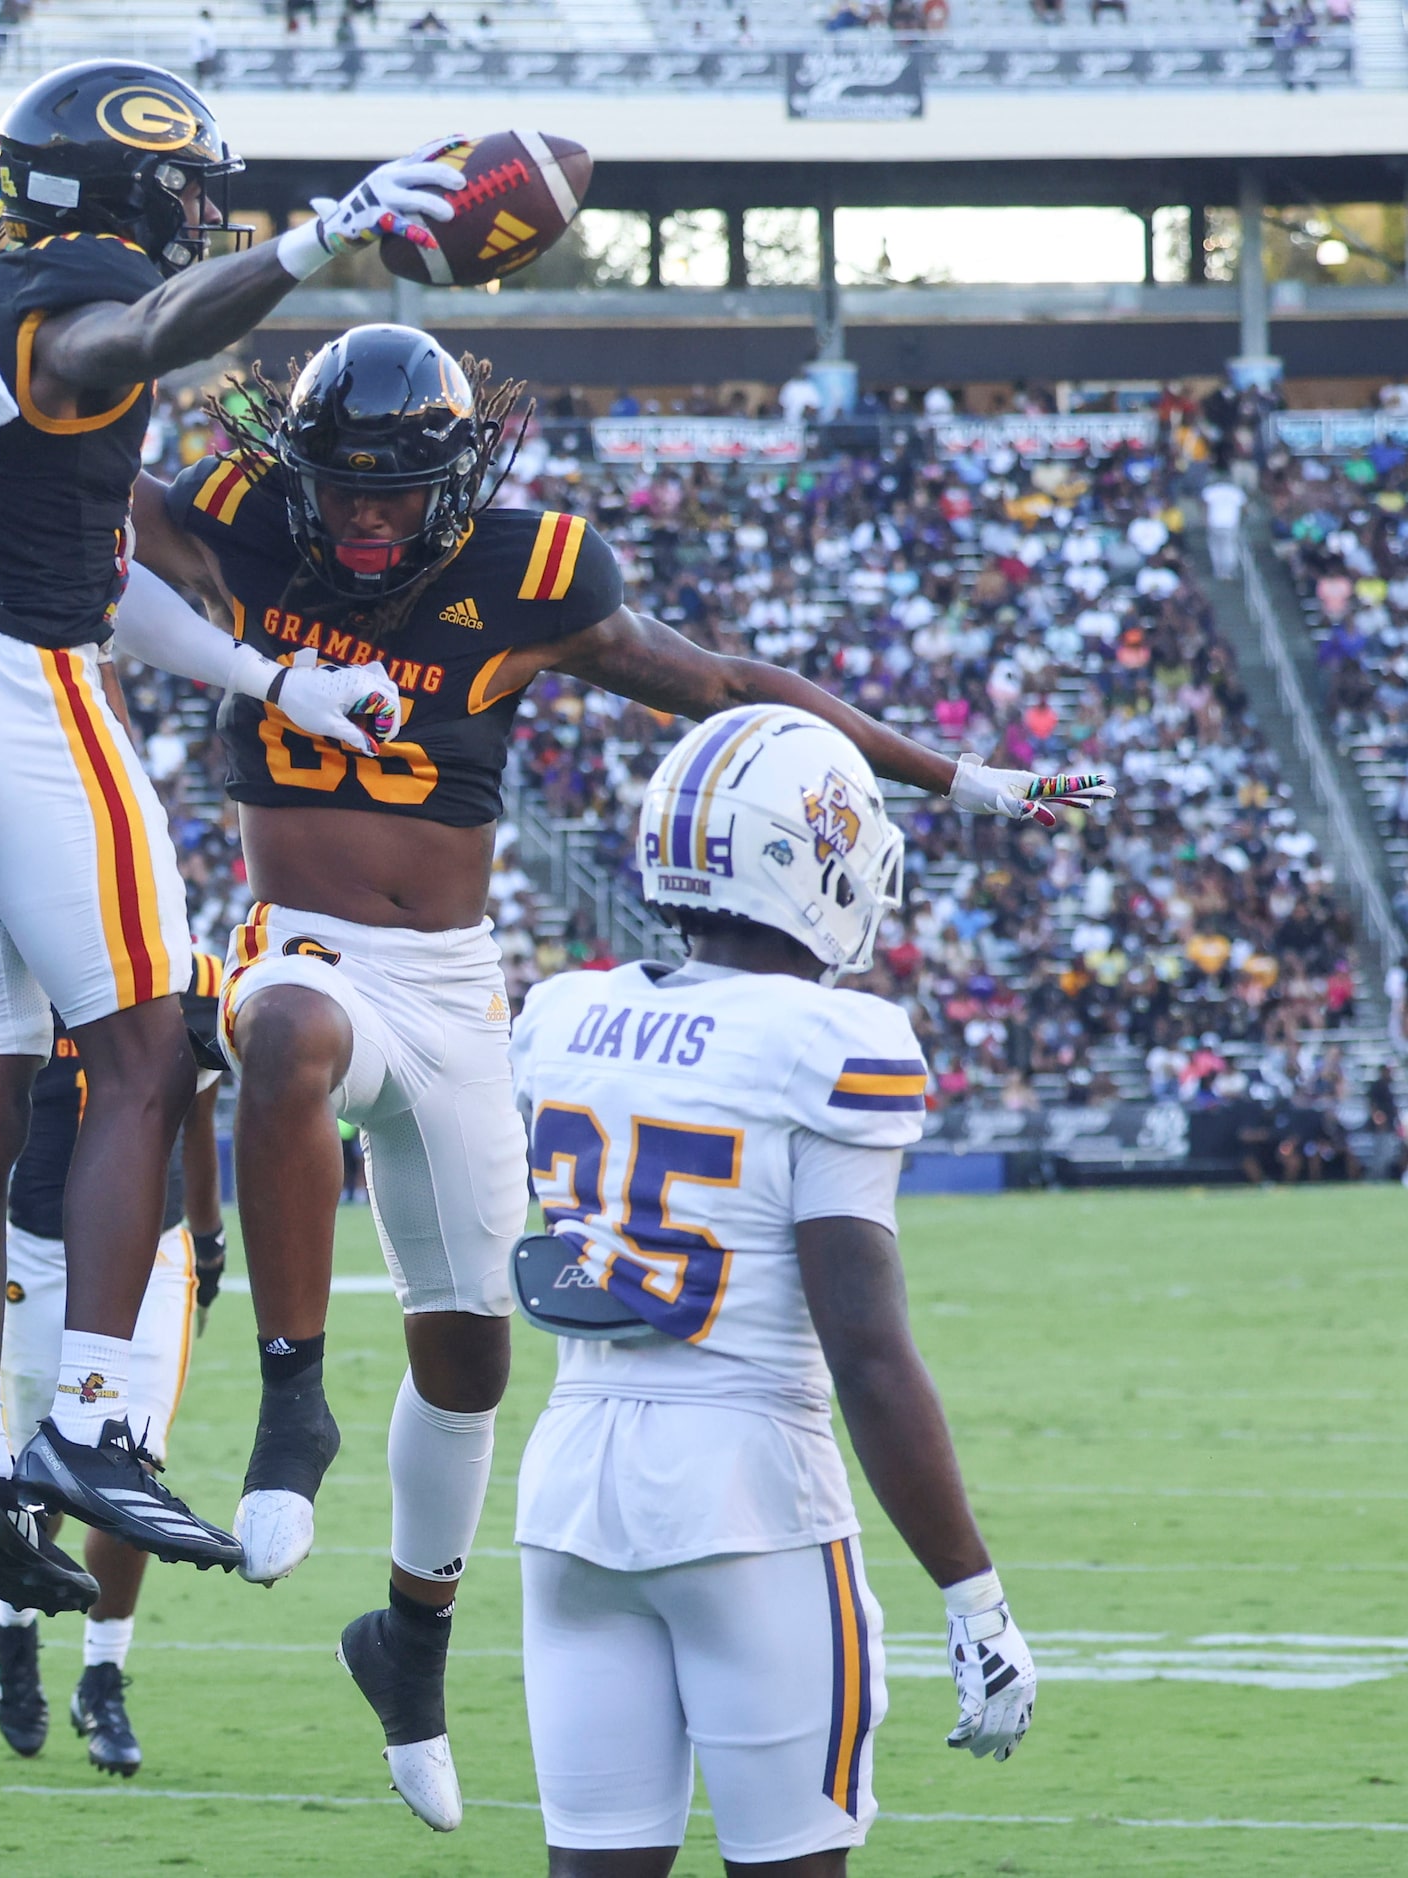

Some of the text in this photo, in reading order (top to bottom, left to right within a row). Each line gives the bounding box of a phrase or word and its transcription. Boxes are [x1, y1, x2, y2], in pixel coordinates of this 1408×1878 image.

[438, 611, 484, 630] adidas
[567, 1004, 716, 1067] DAVIS
[532, 1099, 745, 1344] 25
